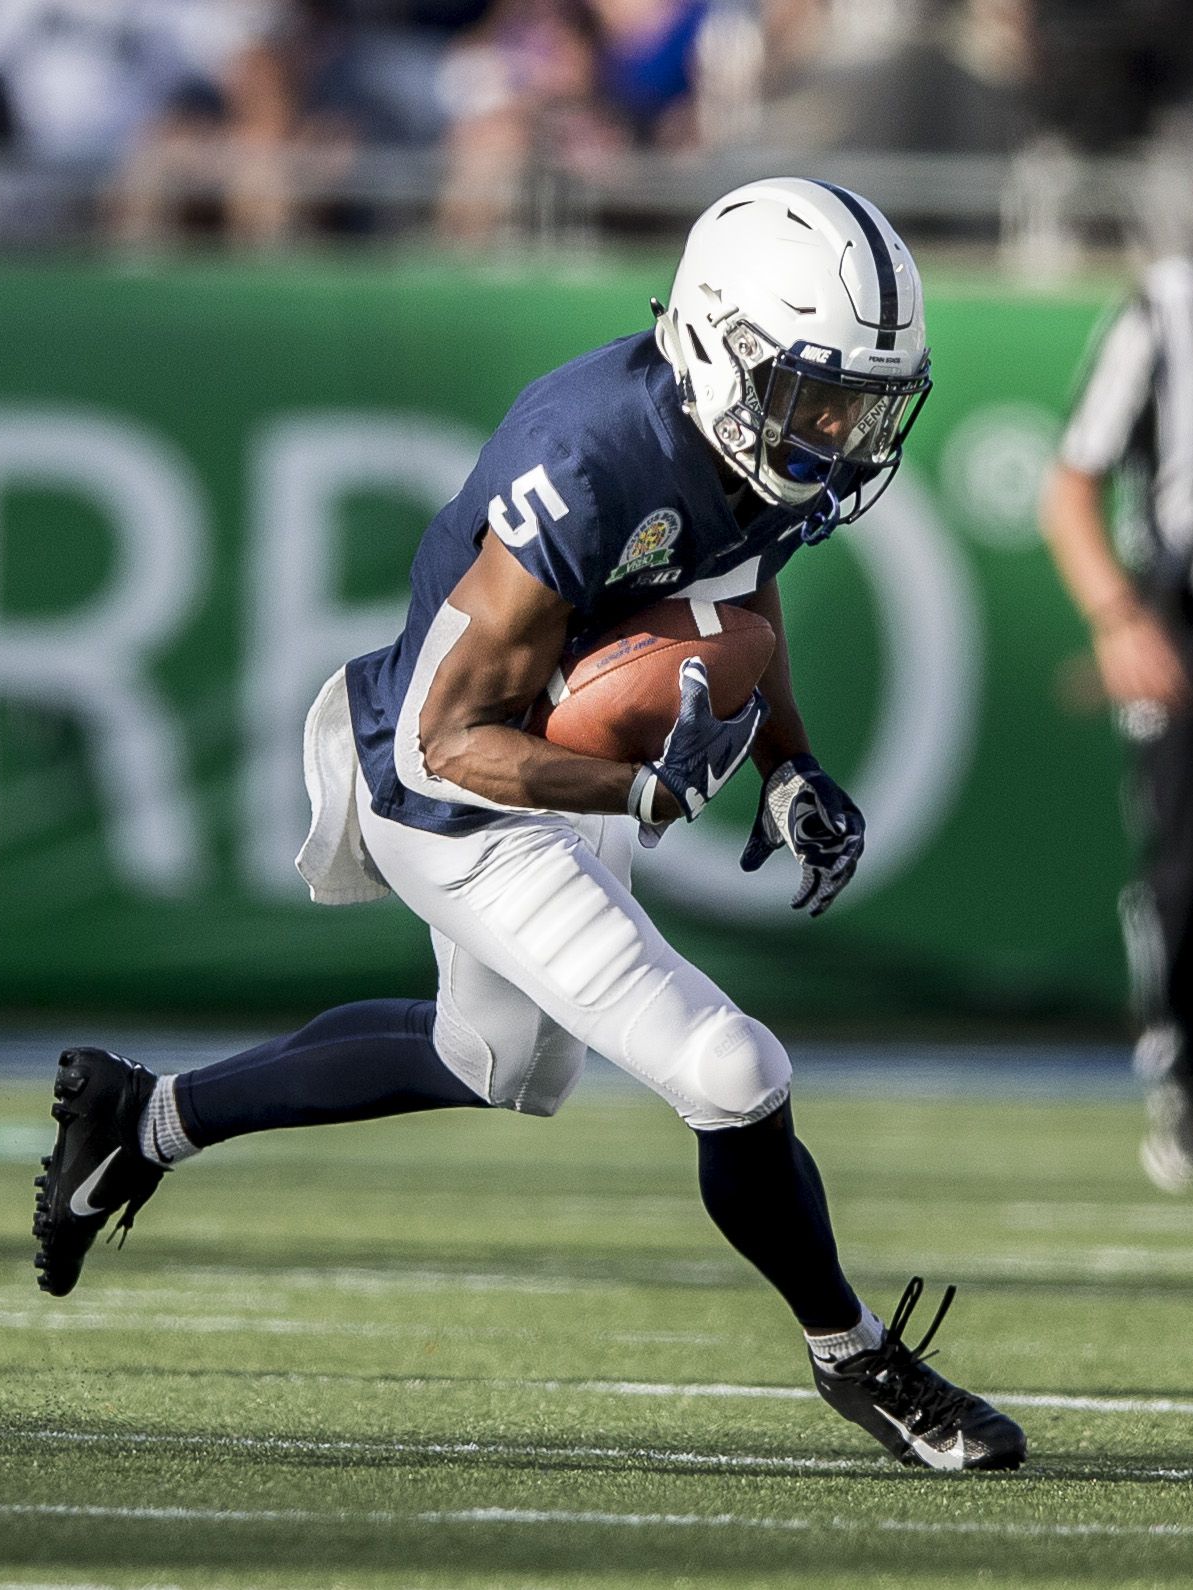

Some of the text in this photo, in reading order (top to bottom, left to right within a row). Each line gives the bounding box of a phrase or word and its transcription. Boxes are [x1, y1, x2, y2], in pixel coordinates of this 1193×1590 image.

[799, 344, 833, 364] NIKE
[858, 400, 887, 435] PENN
[487, 463, 570, 548] 5
